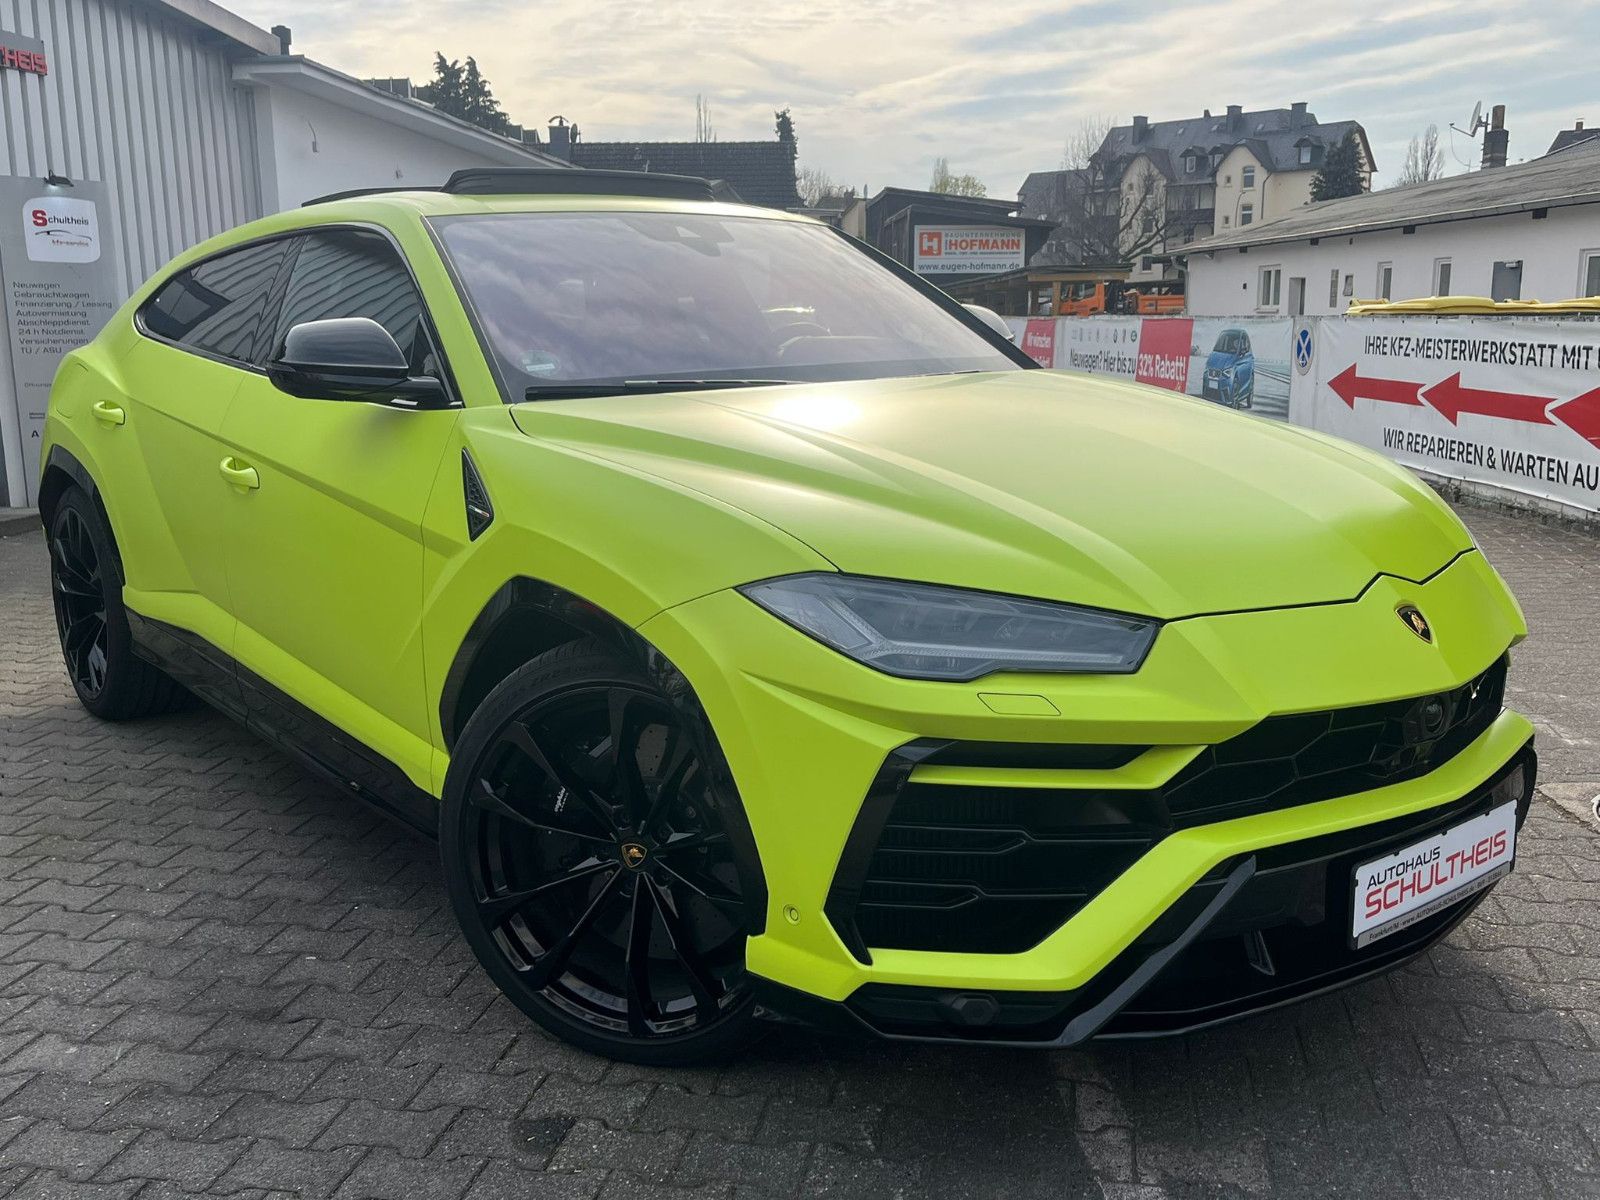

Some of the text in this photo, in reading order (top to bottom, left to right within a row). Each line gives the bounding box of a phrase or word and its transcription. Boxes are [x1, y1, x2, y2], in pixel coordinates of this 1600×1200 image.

[32, 210, 89, 227] Schultheis
[949, 239, 1021, 250] HOFMANN
[918, 262, 1020, 271] www.eugen-hofmann.de
[13, 281, 60, 290] Neuwagen
[13, 291, 90, 299] Gebrauchtwagen
[16, 310, 87, 318] Autovermietung
[17, 319, 90, 327] Abschleppdienst
[18, 328, 31, 336] 24
[41, 328, 84, 336] Notdienst
[19, 338, 89, 346] Versicherungen
[1364, 335, 1388, 355] IHRE
[1389, 336, 1558, 368] KFZ-MEISTERWERKSTATT
[1561, 344, 1593, 370] MIT
[1070, 348, 1102, 373] Neuwagen?
[1103, 350, 1116, 372] Hier
[1117, 351, 1127, 373] bis
[1128, 357, 1136, 374] zu
[1138, 353, 1154, 377] 32%
[1155, 354, 1186, 381] Rabatt!
[1383, 427, 1404, 450] WIR
[1406, 435, 1483, 467] REPARIEREN
[1487, 447, 1496, 469] &
[1500, 449, 1568, 484] WARTEN
[1367, 846, 1440, 890] AUTOHAUS
[1365, 829, 1506, 919] SCHULTHEIS
